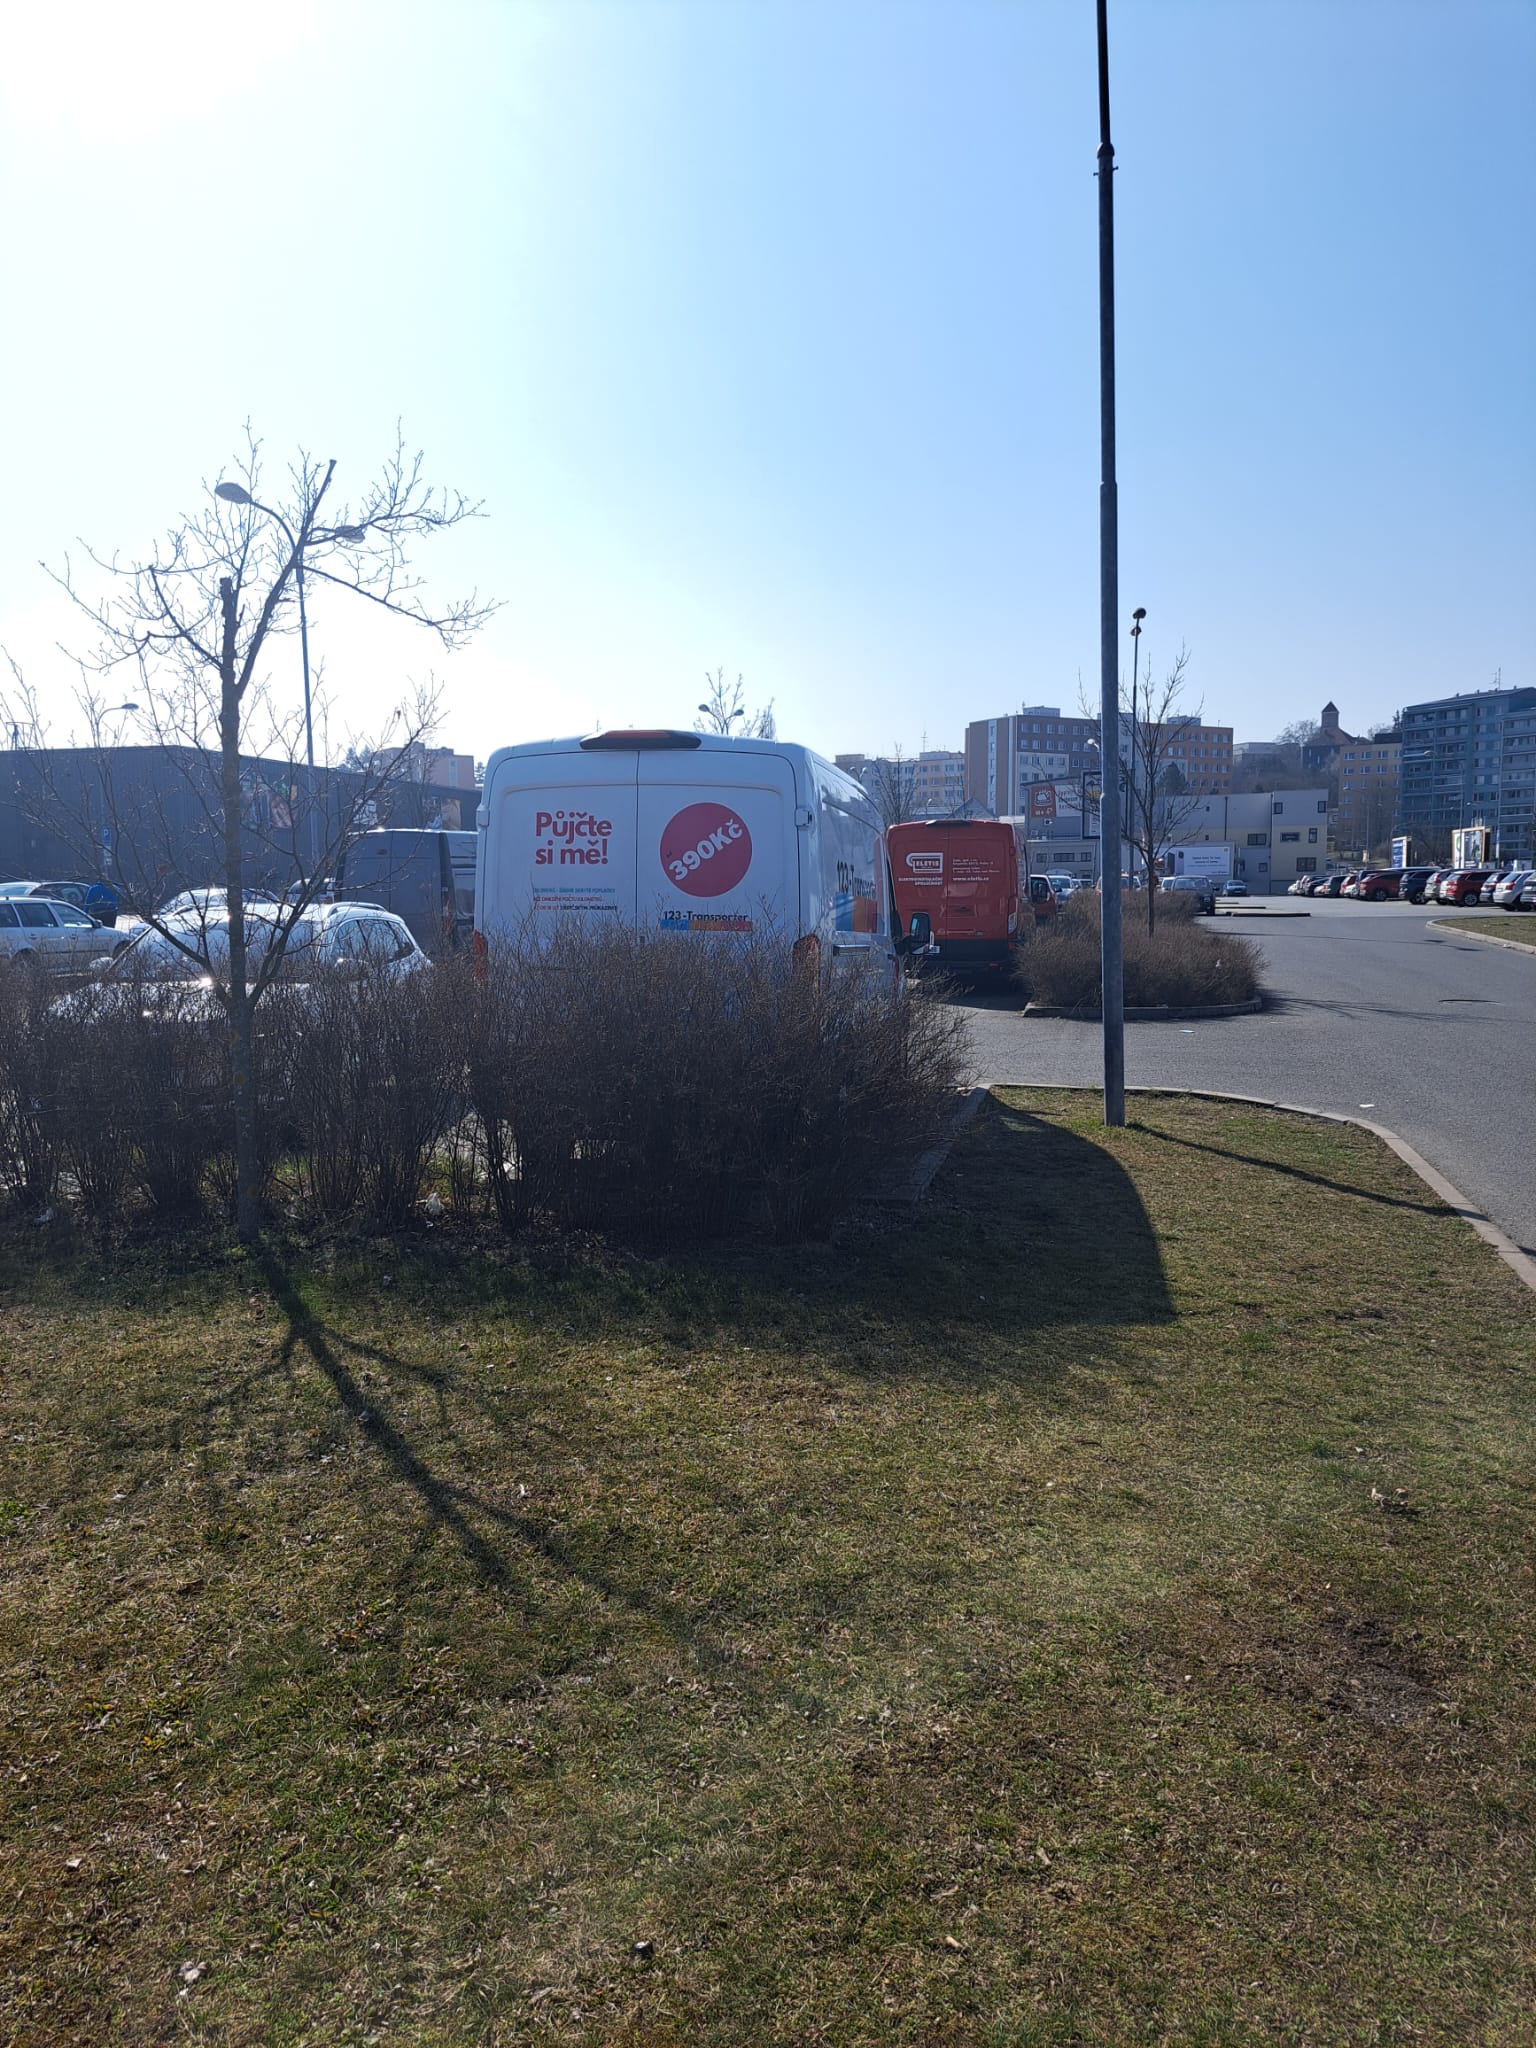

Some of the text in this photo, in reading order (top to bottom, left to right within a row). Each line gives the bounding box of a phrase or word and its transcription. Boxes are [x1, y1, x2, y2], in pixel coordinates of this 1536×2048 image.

[535, 810, 612, 844] Půjčte
[535, 839, 608, 865] si mě!
[668, 818, 744, 881] 390Kč
[663, 910, 749, 922] 123-Transporter
